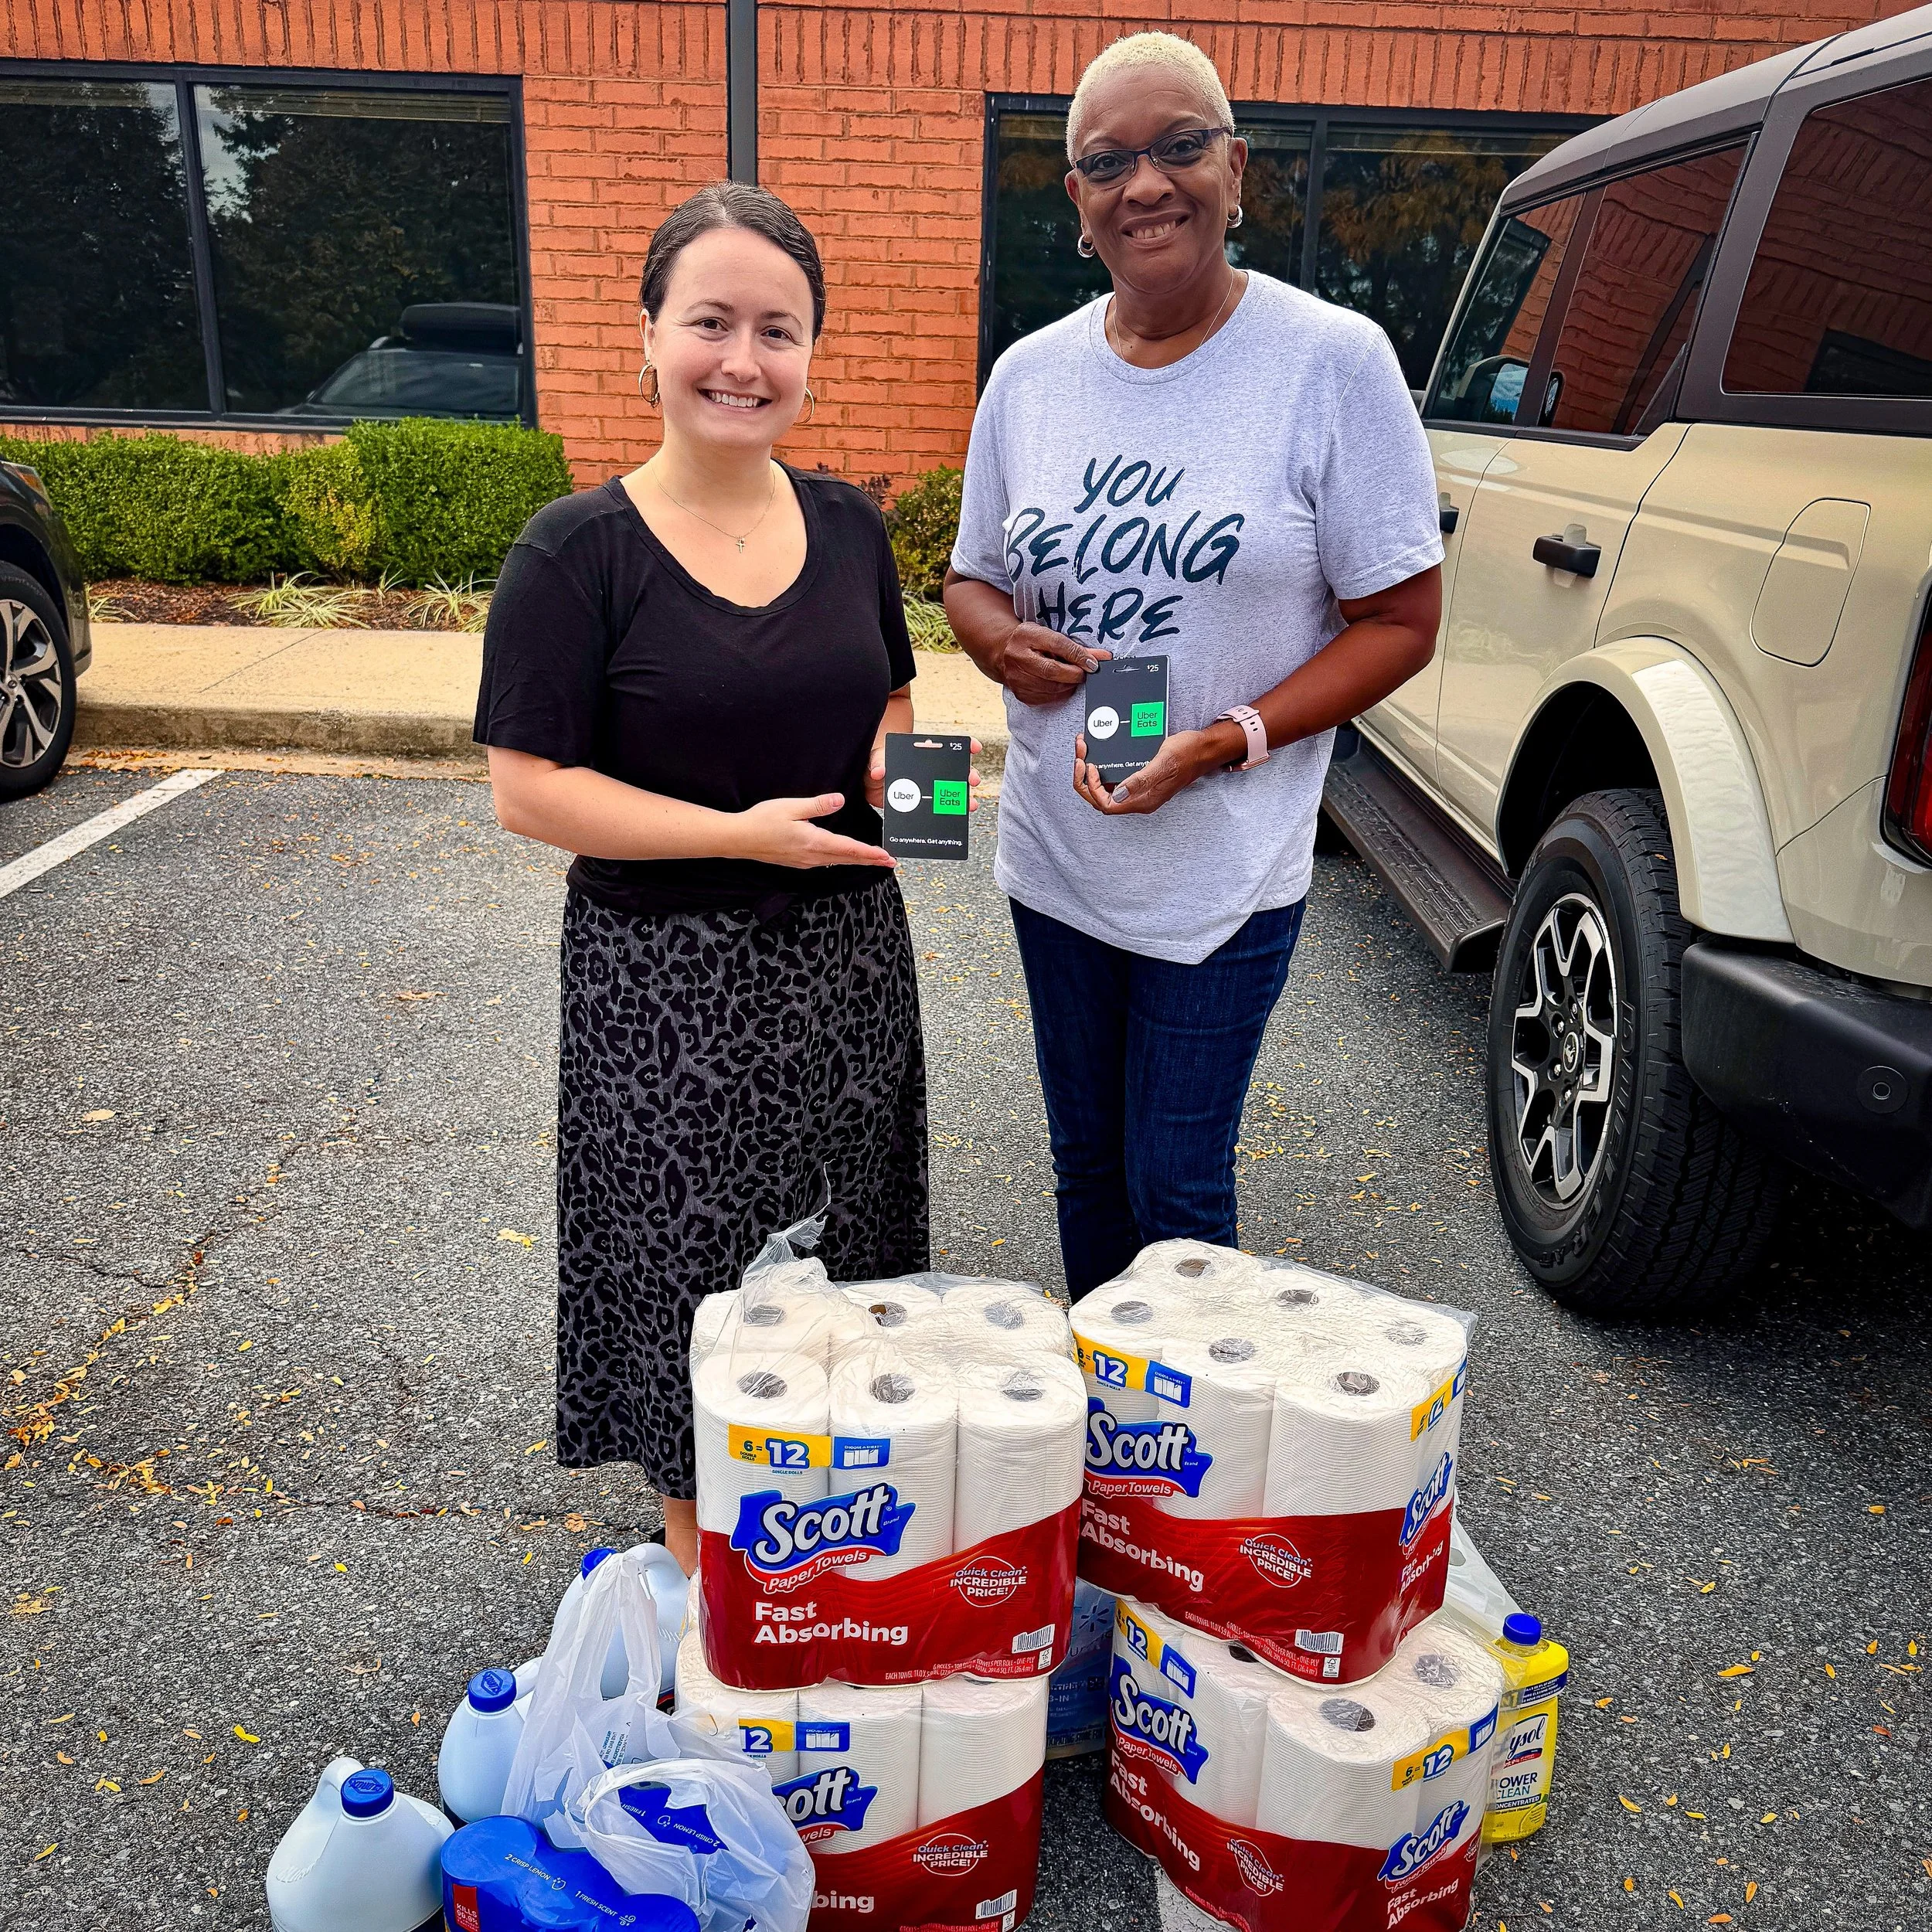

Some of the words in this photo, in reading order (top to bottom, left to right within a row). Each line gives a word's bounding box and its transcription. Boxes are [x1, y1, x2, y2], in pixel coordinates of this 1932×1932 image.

[1073, 454, 1186, 515] YOU
[1004, 507, 1246, 586] BELONG
[1037, 580, 1185, 644] HERE
[1093, 719, 1113, 728] Uber
[1137, 711, 1158, 719] Uber
[1137, 719, 1158, 728] Eats
[949, 742, 963, 750] $25
[893, 791, 914, 800] Uber
[940, 789, 961, 798] Uber
[1095, 1353, 1125, 1384] 12
[743, 1440, 753, 1452] 6
[769, 1441, 806, 1466] 12
[1085, 1411, 1189, 1471] Scott
[1092, 1480, 1127, 1496] Paper
[1128, 1481, 1172, 1495] Towels
[755, 1485, 889, 1563] Scott
[1081, 1497, 1131, 1536] Fast
[1080, 1521, 1205, 1592] Absorbing
[1240, 1544, 1312, 1578] INCREDIBLE
[1244, 1538, 1277, 1553] Quick
[1277, 1548, 1308, 1566] Clean
[768, 1566, 815, 1591] Paper
[815, 1549, 868, 1572] Towels
[949, 1576, 1028, 1587] INCREDIBLE
[955, 1567, 988, 1577] Quick
[990, 1569, 1022, 1577] Clean
[1257, 1556, 1294, 1582] PRICE!
[966, 1587, 1009, 1597] PRICE!
[754, 1600, 817, 1622] Fast
[753, 1617, 909, 1646] Absorbing
[1128, 1619, 1147, 1656] 12
[1114, 1674, 1192, 1754] Scott
[739, 1729, 770, 1750] 12
[1505, 1716, 1546, 1760] ysol
[1117, 1736, 1148, 1756] Paper
[1148, 1747, 1179, 1773] Towels
[1426, 1748, 1452, 1776] 12
[1111, 1748, 1148, 1797] Fast
[775, 1768, 852, 1821] ott
[1495, 1795, 1540, 1809] ONCENTRATED
[673, 1823, 696, 1835] LEMON
[801, 1826, 832, 1843] wels
[1110, 1771, 1200, 1872] Absorbing
[696, 1832, 714, 1845] CRISP
[917, 1844, 950, 1853] Quick
[952, 1843, 984, 1852] Clean
[1391, 1801, 1461, 1876] Scott
[511, 1856, 530, 1869] CRISP
[529, 1864, 551, 1881] LEMON
[913, 1850, 988, 1862] INCREDIBLE
[930, 1859, 971, 1868] PRICE!
[1226, 1842, 1284, 1892] INCREDIBLE
[1240, 1859, 1267, 1892] PRICE!
[456, 1903, 478, 1918] KILLS
[580, 1893, 599, 1907] FRESH
[597, 1903, 618, 1917] SCENT
[1386, 1888, 1417, 1915] Fast
[1386, 1878, 1459, 1930] Absorbing
